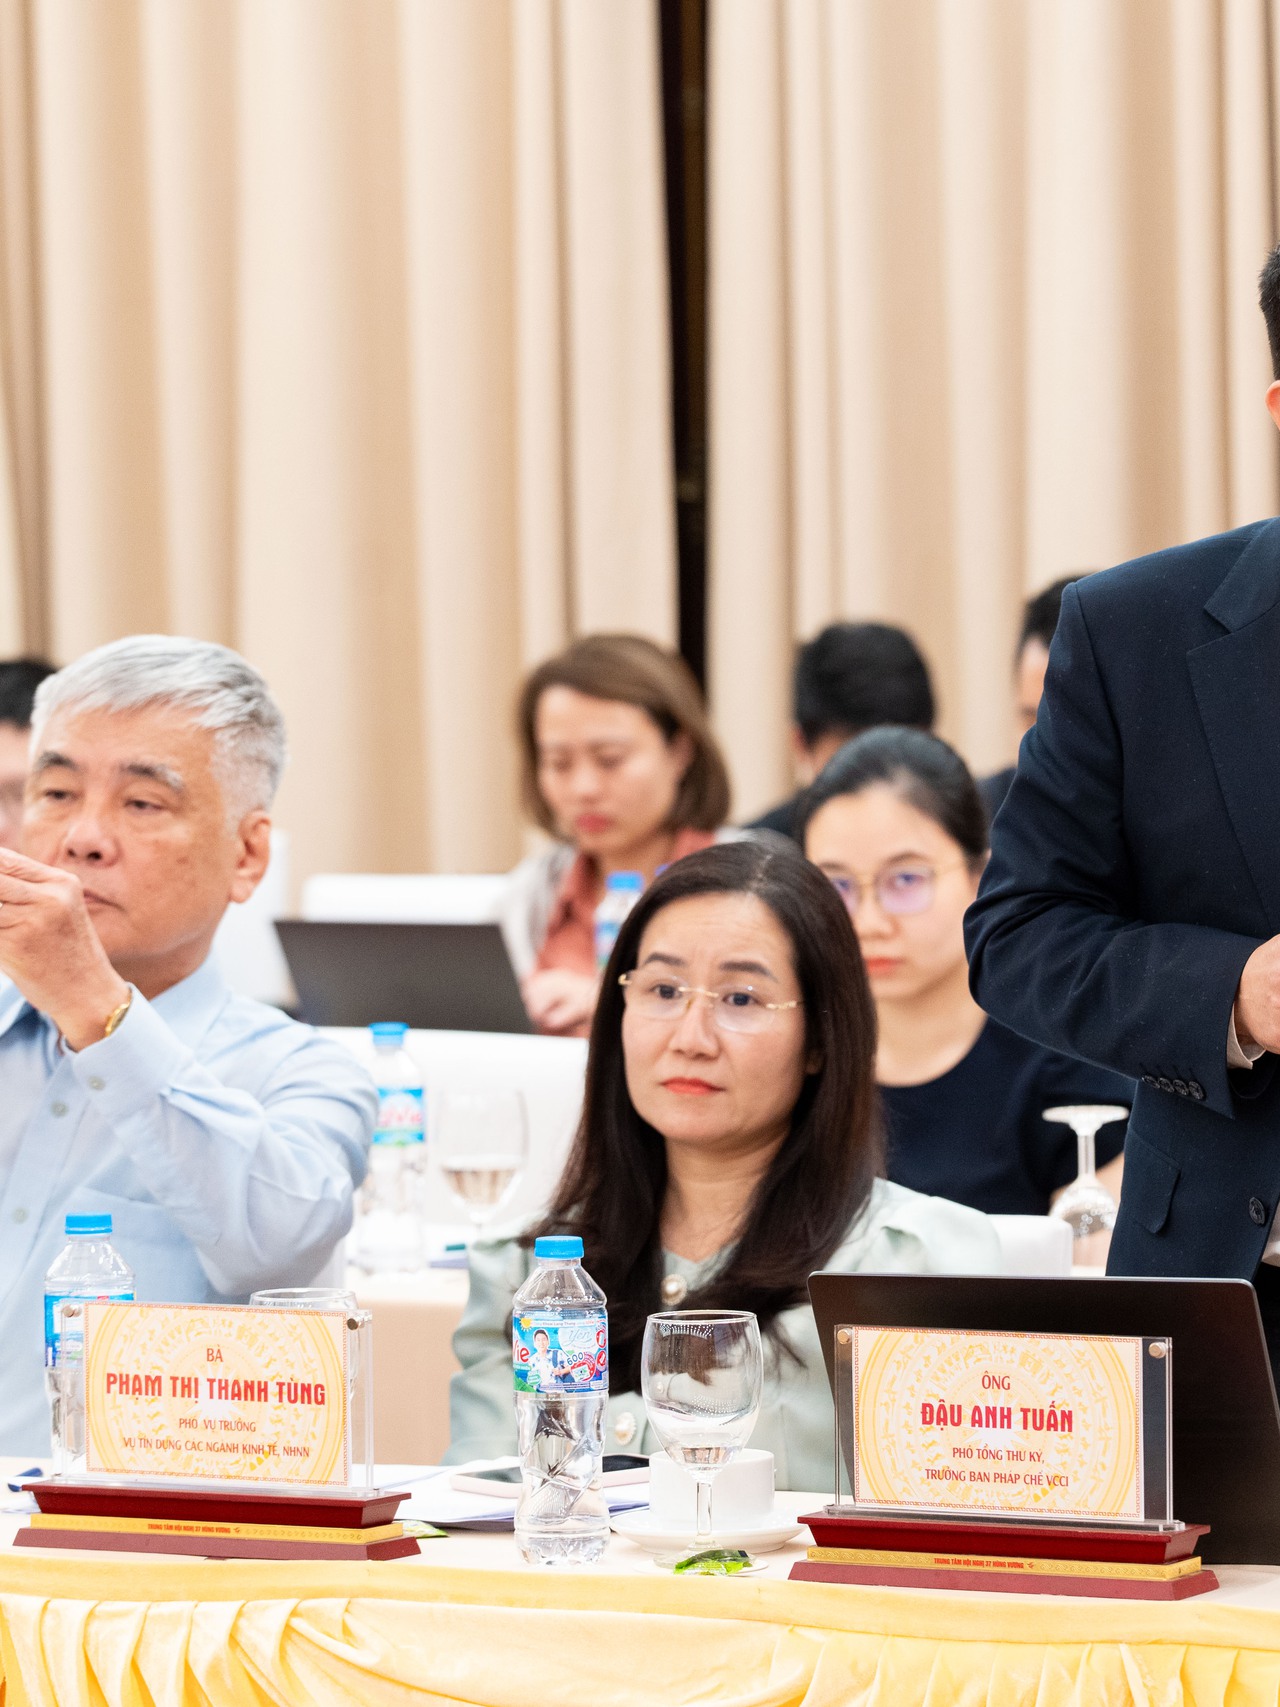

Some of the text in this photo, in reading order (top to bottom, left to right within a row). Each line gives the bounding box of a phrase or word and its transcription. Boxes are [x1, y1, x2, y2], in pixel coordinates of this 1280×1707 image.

[206, 1344, 224, 1362] BÀ
[567, 1352, 584, 1366] 600
[106, 1372, 326, 1406] PHẠM THỊ THANH TÙNG
[982, 1370, 1011, 1390] ÔNG
[920, 1399, 1074, 1432] ĐẬU ANH TUẤN
[204, 1420, 216, 1432] VỤ
[124, 1438, 136, 1450] VỤ
[242, 1444, 265, 1456] KINH
[283, 1446, 310, 1458] NHNN
[952, 1446, 973, 1459] PHÓ
[976, 1444, 1003, 1461] TỔNG
[1006, 1450, 1026, 1462] THƯ
[925, 1466, 1069, 1487] TRƯỞNG BAN PHÁP CHẾ VCCI
